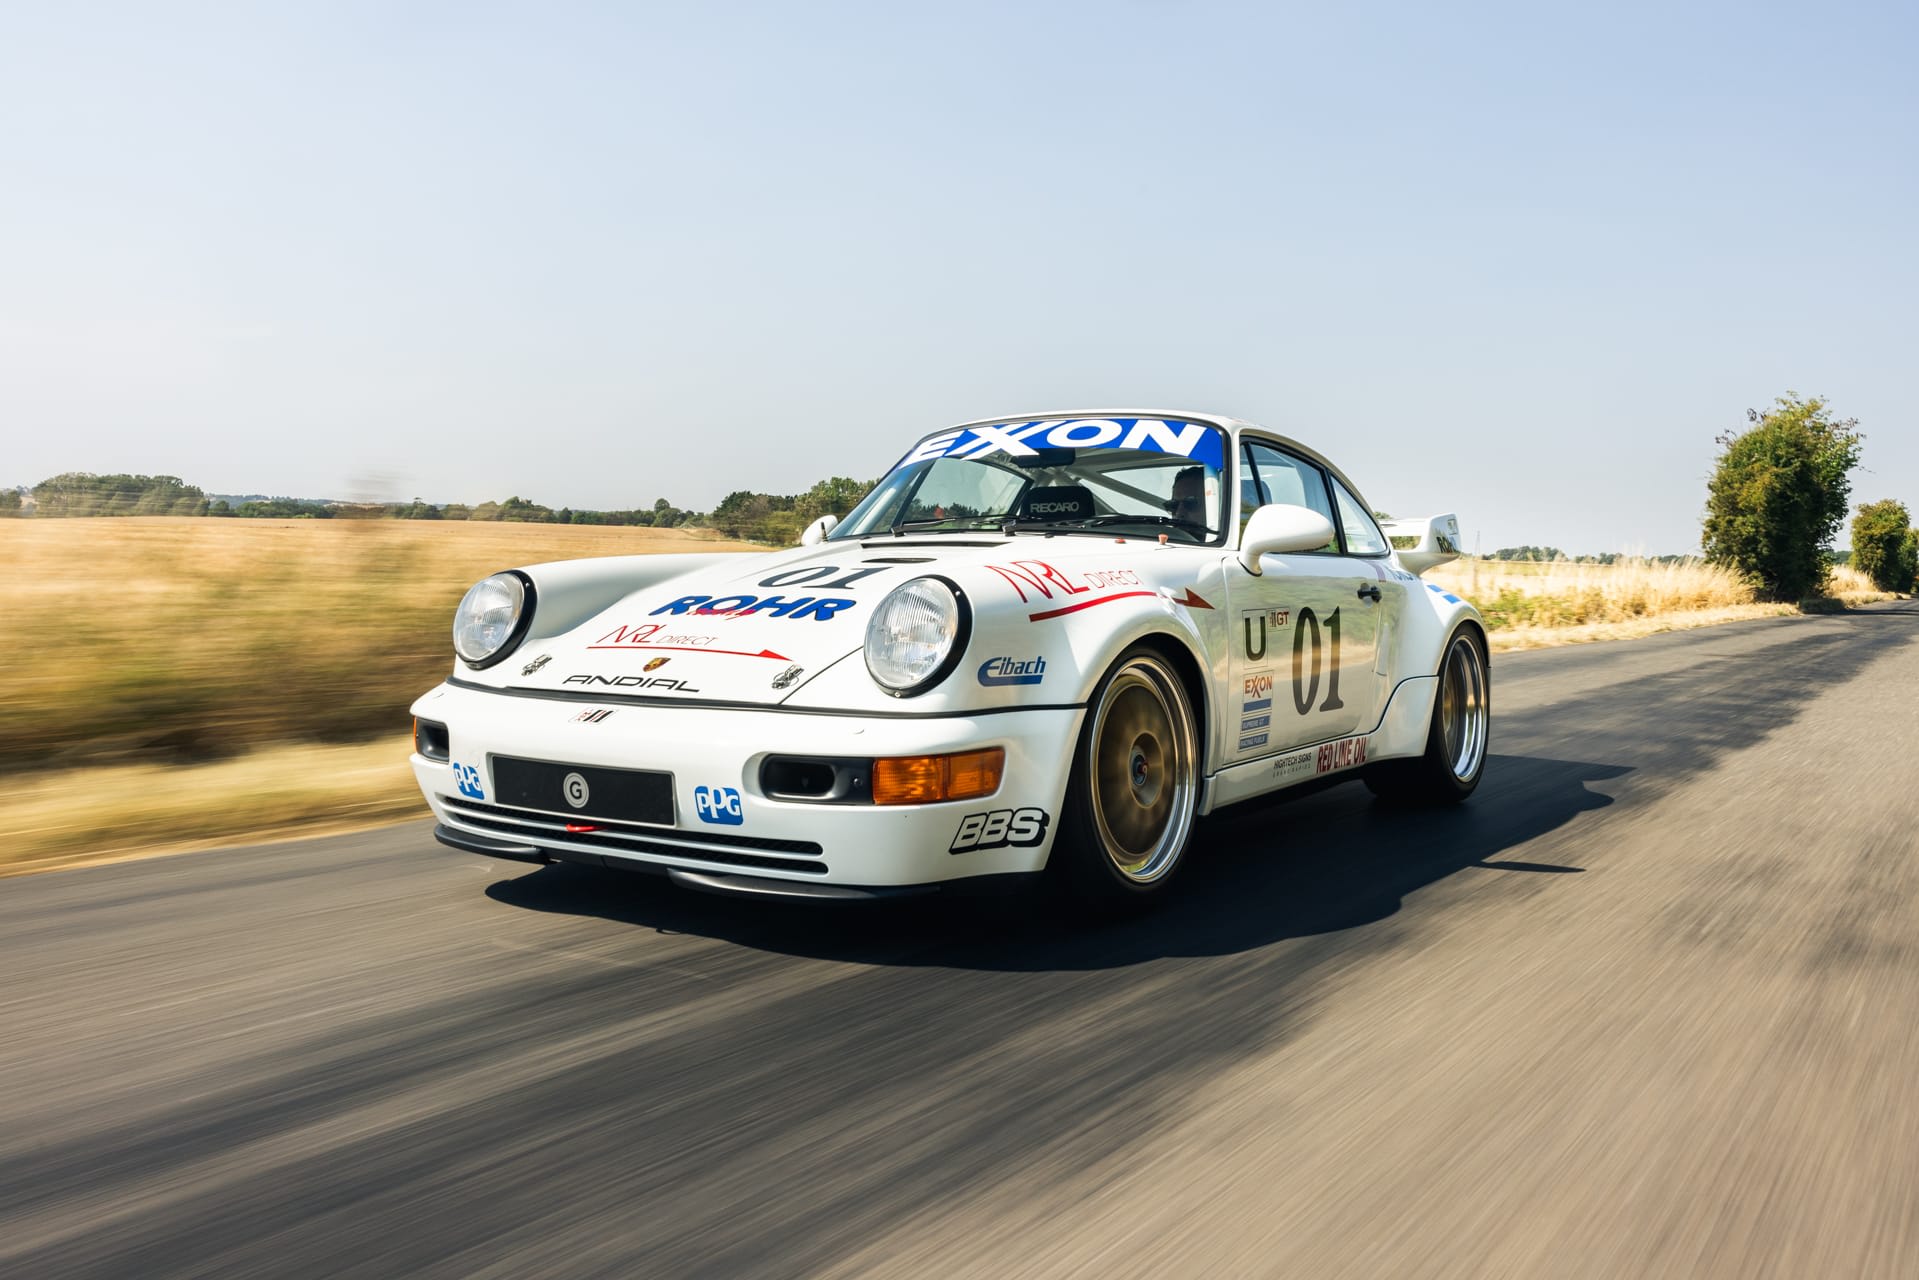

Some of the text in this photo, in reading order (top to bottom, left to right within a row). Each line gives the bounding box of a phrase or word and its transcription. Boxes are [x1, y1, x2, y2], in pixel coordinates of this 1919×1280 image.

[1029, 501, 1080, 513] RECARO
[758, 566, 893, 589] 01
[984, 559, 1144, 604] NRL DIRECT
[648, 595, 857, 621] ROHR
[656, 635, 719, 645] DIRECT
[1244, 616, 1266, 661] U
[977, 655, 1047, 687] Eibach
[1292, 605, 1344, 716] 01
[563, 674, 701, 693] ANDIAL
[1244, 675, 1273, 698] EXXON
[1298, 752, 1312, 764] SIGNS
[1316, 737, 1367, 774] RED LINE OIL
[454, 765, 482, 792] PPG
[569, 780, 583, 800] G
[696, 787, 741, 819] PPG
[949, 807, 1051, 855] BBS
